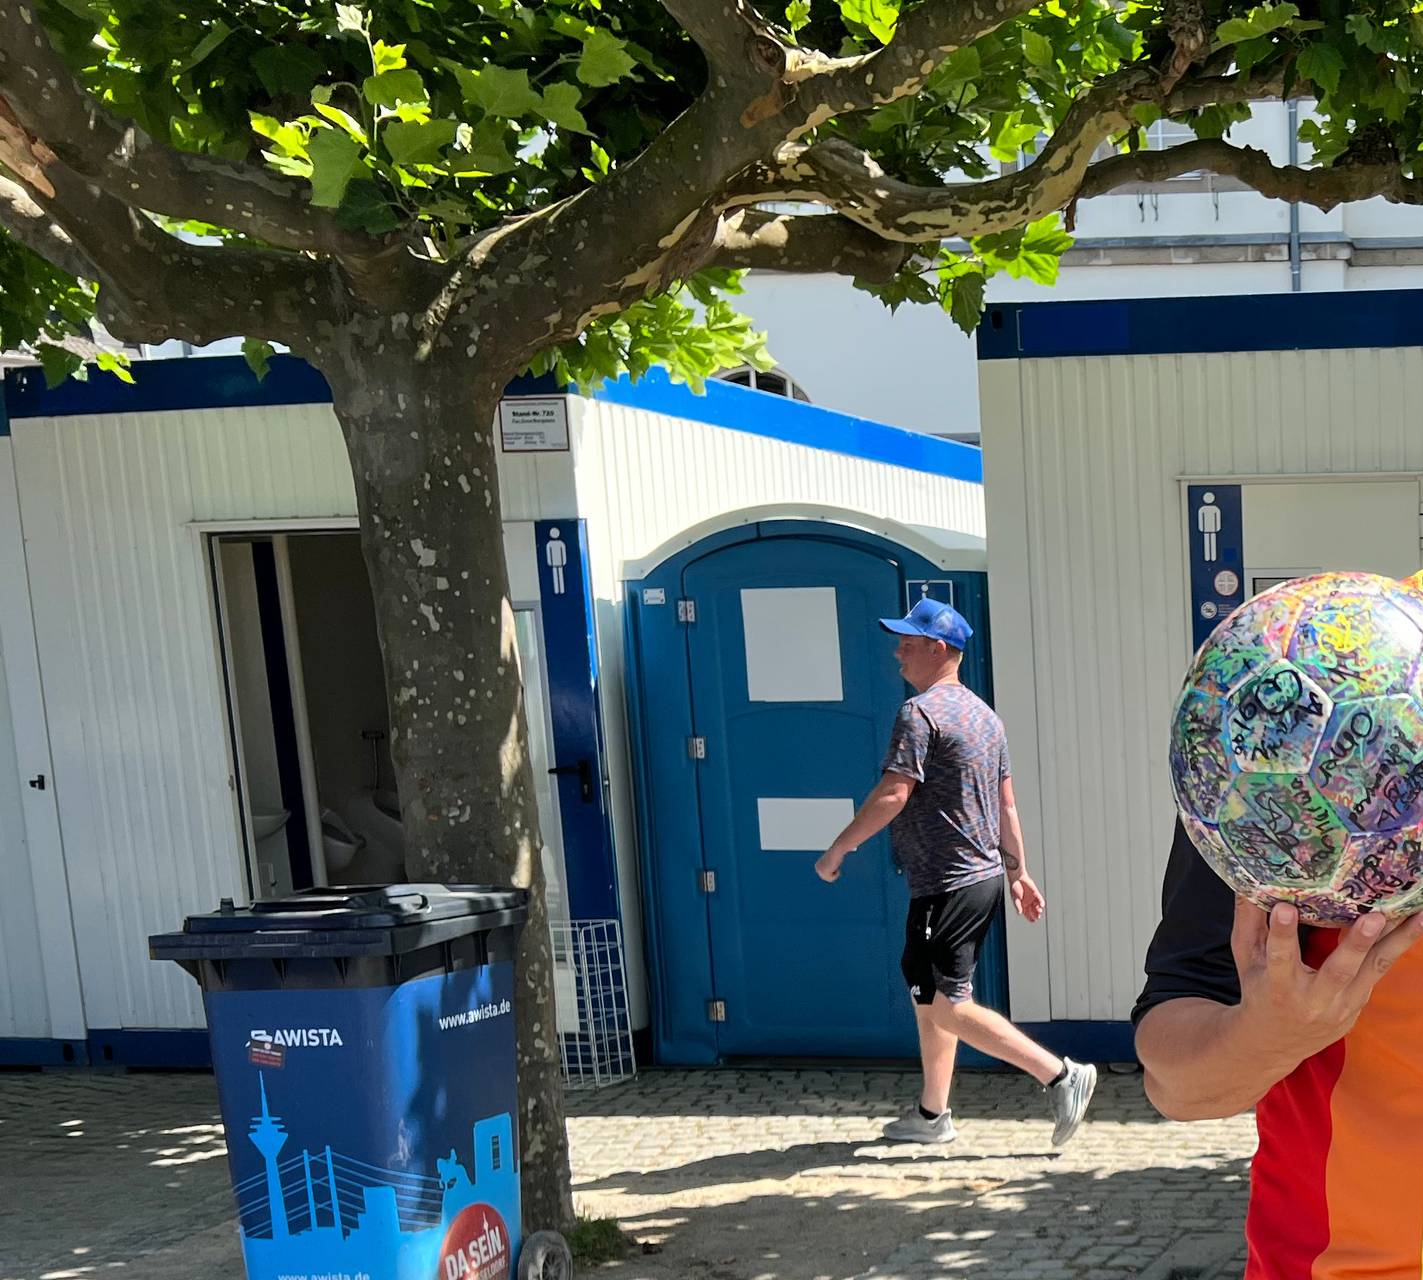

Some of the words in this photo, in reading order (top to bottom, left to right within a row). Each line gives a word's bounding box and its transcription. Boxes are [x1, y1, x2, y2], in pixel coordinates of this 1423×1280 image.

[438, 998, 511, 1031] www.awista.de
[273, 1028, 344, 1048] AWISTA
[277, 1271, 371, 1280] wwwawistade
[445, 1247, 471, 1280] DA
